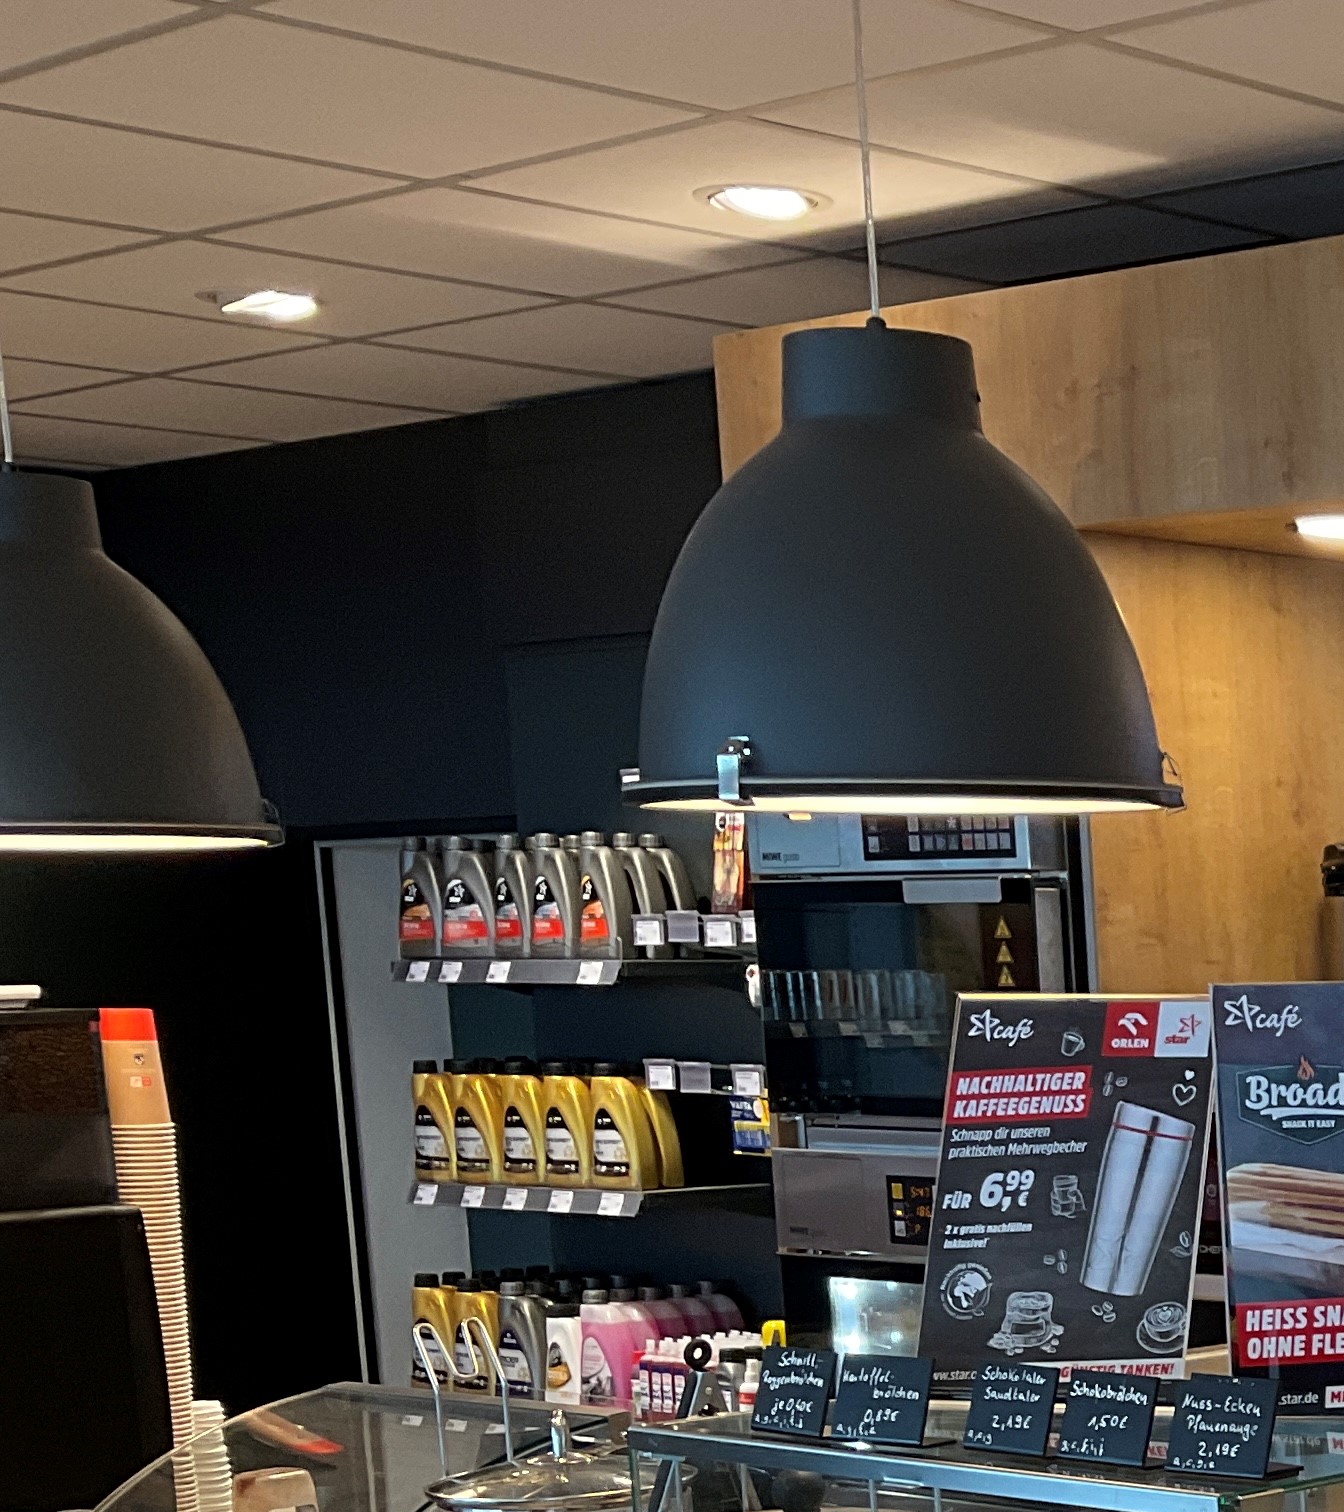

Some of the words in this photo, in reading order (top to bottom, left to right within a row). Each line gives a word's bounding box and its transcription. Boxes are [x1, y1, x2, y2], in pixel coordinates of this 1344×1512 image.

[1112, 1038, 1148, 1048] ORLEN
[1164, 1033, 1190, 1044] star
[956, 1071, 1084, 1095] NACHHALTIGER
[953, 1095, 1085, 1118] KAFFEEGENUSS
[951, 1128, 992, 1142] Schnapp
[995, 1127, 1008, 1139] dir
[1011, 1126, 1050, 1138] unseren
[948, 1143, 1004, 1160] praktischen
[1007, 1141, 1087, 1158] Mehrwegbecher
[942, 1191, 972, 1209] FÜR
[959, 1224, 985, 1236] gratis
[987, 1222, 1032, 1232] nachfüllen
[1246, 1307, 1307, 1331] HEISS
[1247, 1335, 1305, 1359] OHNE
